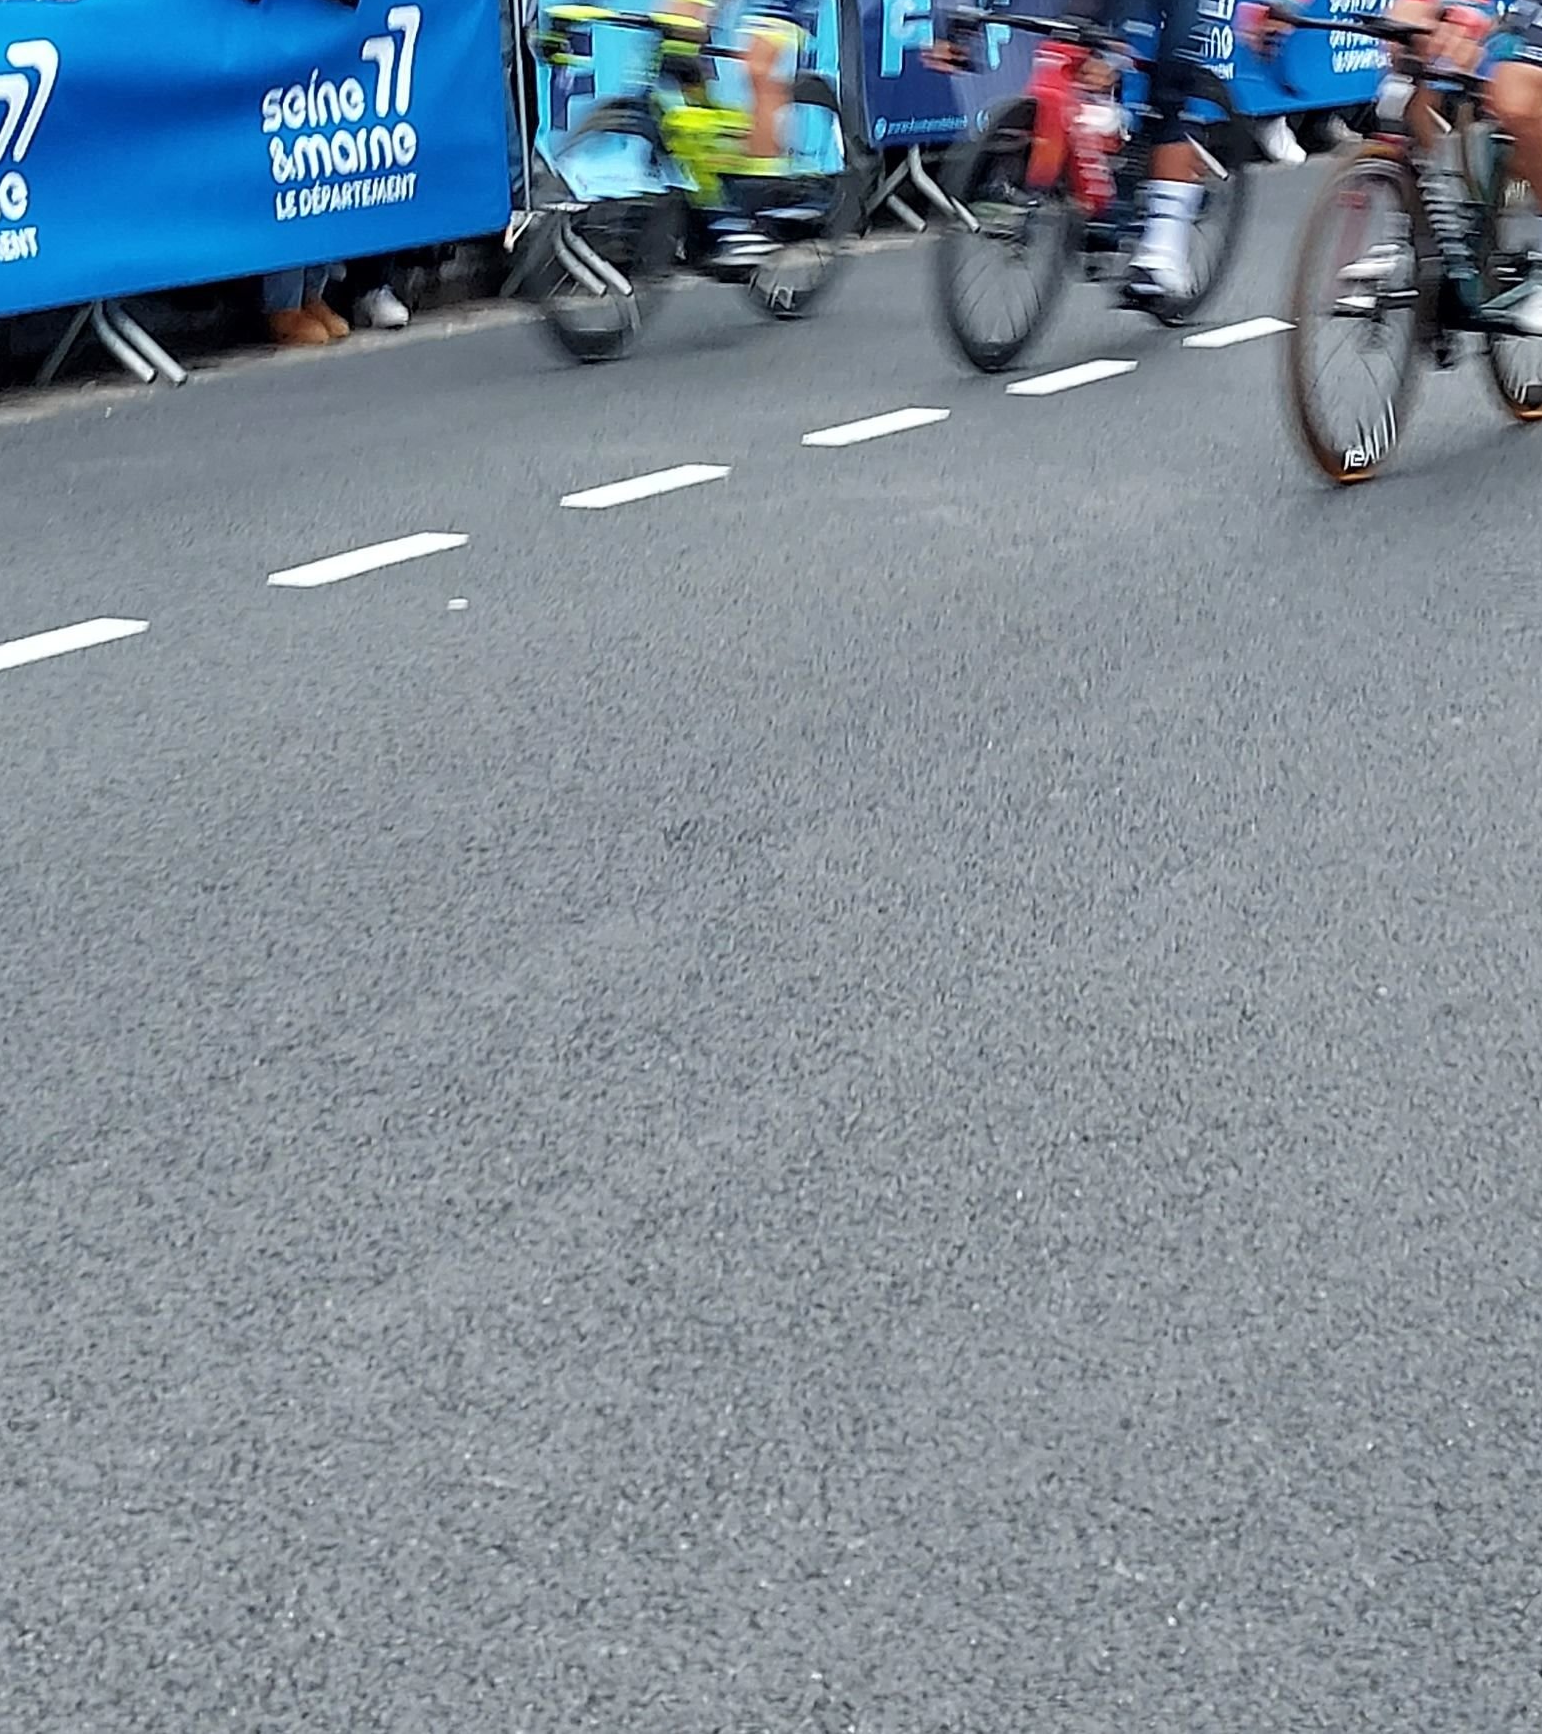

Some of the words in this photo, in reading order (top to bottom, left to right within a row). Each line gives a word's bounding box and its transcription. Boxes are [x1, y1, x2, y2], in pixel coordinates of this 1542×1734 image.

[362, 4, 420, 118] 77
[262, 67, 365, 133] seine
[275, 189, 297, 221] LE
[298, 171, 417, 217] DÉPARTEMENT
